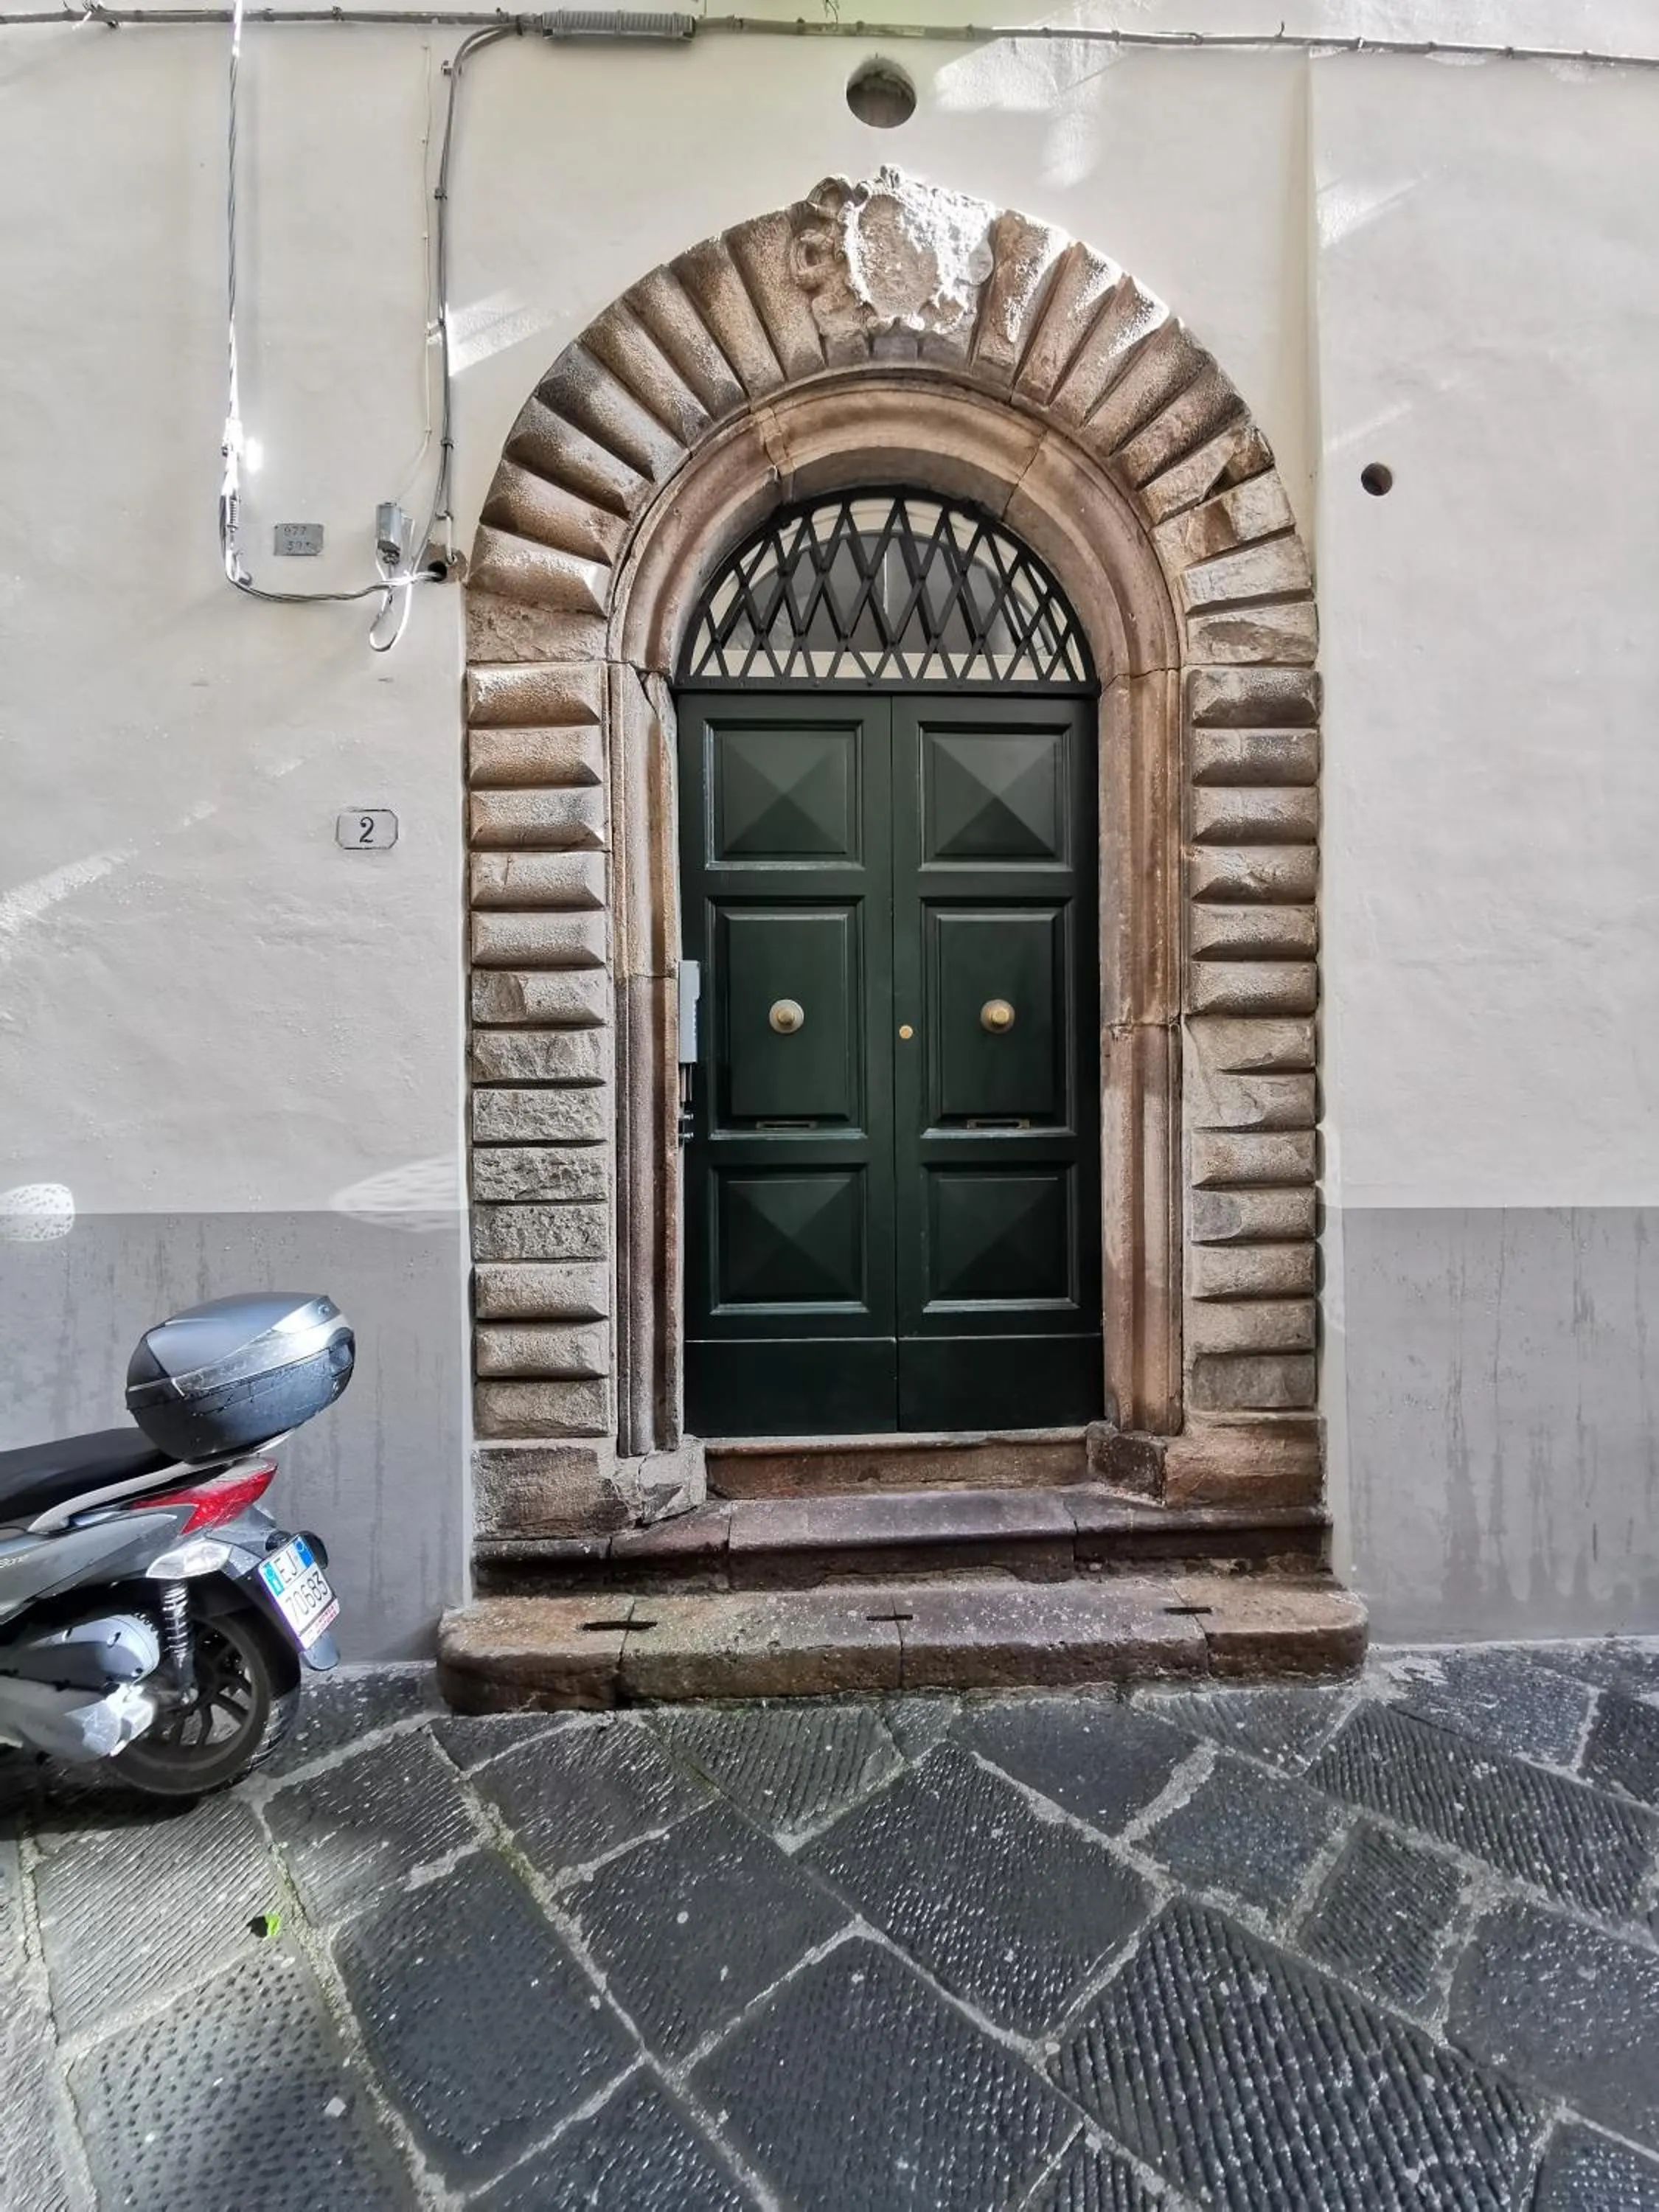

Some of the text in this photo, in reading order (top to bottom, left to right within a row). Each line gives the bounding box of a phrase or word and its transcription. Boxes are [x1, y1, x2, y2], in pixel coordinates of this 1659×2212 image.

[359, 816, 374, 843] 2
[274, 1550, 298, 1584] EJ
[285, 1570, 329, 1625] 70683
